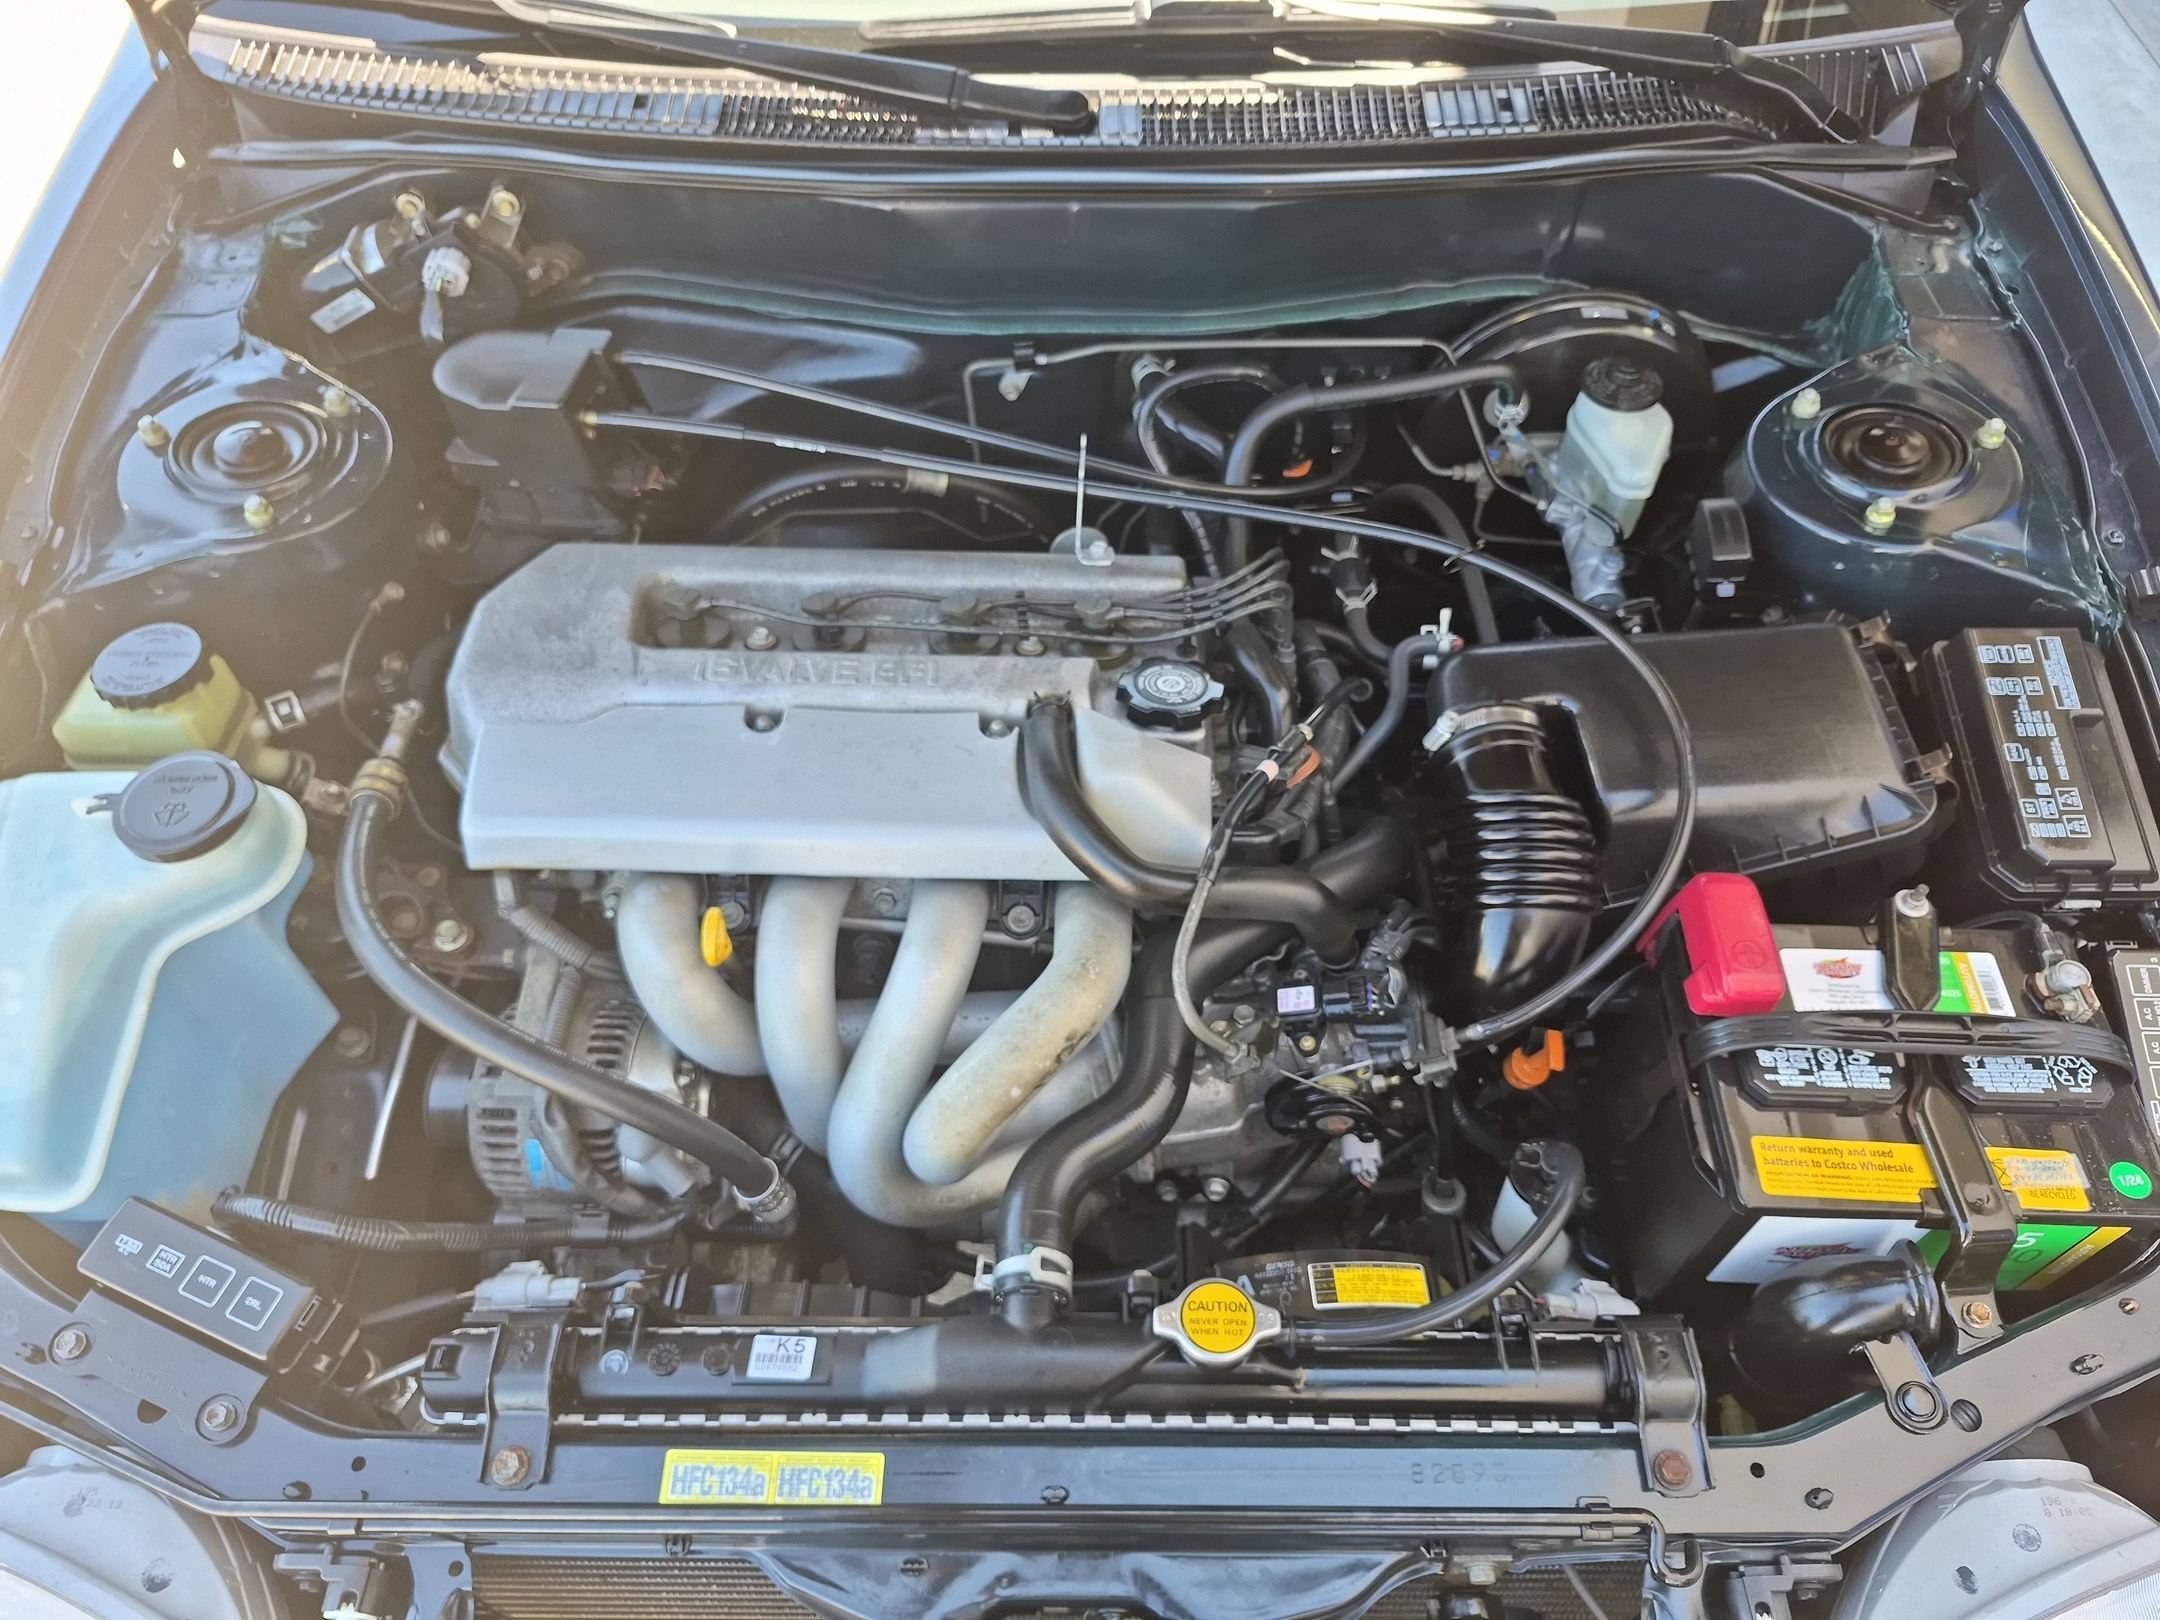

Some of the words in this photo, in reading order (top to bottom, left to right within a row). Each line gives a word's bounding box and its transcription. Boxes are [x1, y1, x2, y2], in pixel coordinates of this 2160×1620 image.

[1760, 1142, 1796, 1153] Return
[1798, 1144, 1844, 1158] warranty
[1847, 1146, 1867, 1157] and
[1870, 1148, 1894, 1158] used
[1763, 1157, 1809, 1168] batteries
[1811, 1159, 1822, 1168] to
[1824, 1159, 1858, 1171] Costco
[1859, 1162, 1914, 1174] Wholesale
[2117, 1174, 2145, 1188] 1/24
[2040, 1190, 2076, 1200] RECYCLED
[197, 1274, 217, 1289] HTR
[1187, 1300, 1248, 1313] CAUTION
[1189, 1317, 1219, 1325] NEVER
[1222, 1318, 1247, 1326] OPEN
[1190, 1327, 1220, 1336] WHEN
[1223, 1328, 1245, 1336] HOT
[670, 1462, 766, 1497] HFC134a
[776, 1467, 873, 1499] HFC134a
